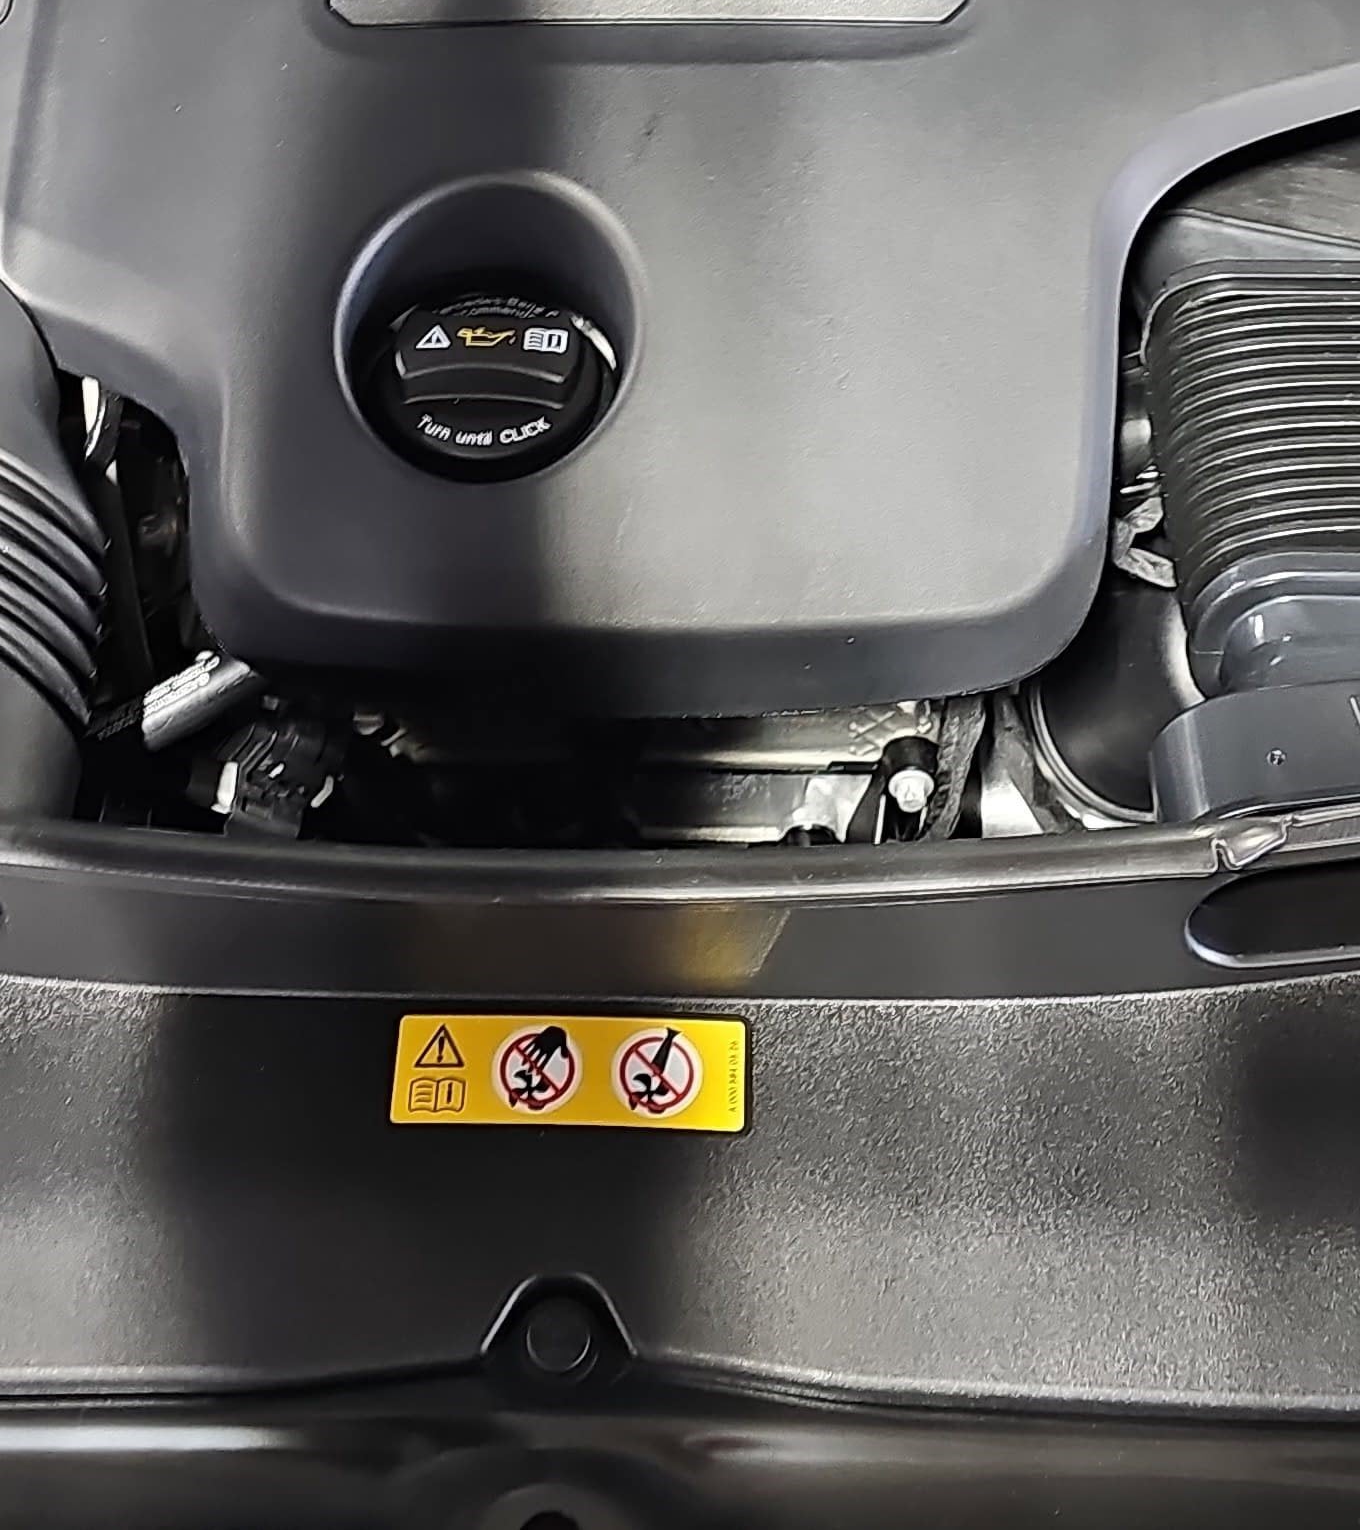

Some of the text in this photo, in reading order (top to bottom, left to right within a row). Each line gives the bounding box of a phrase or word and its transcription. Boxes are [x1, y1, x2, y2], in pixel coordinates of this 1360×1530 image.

[417, 414, 551, 446] Turn until CLICK
